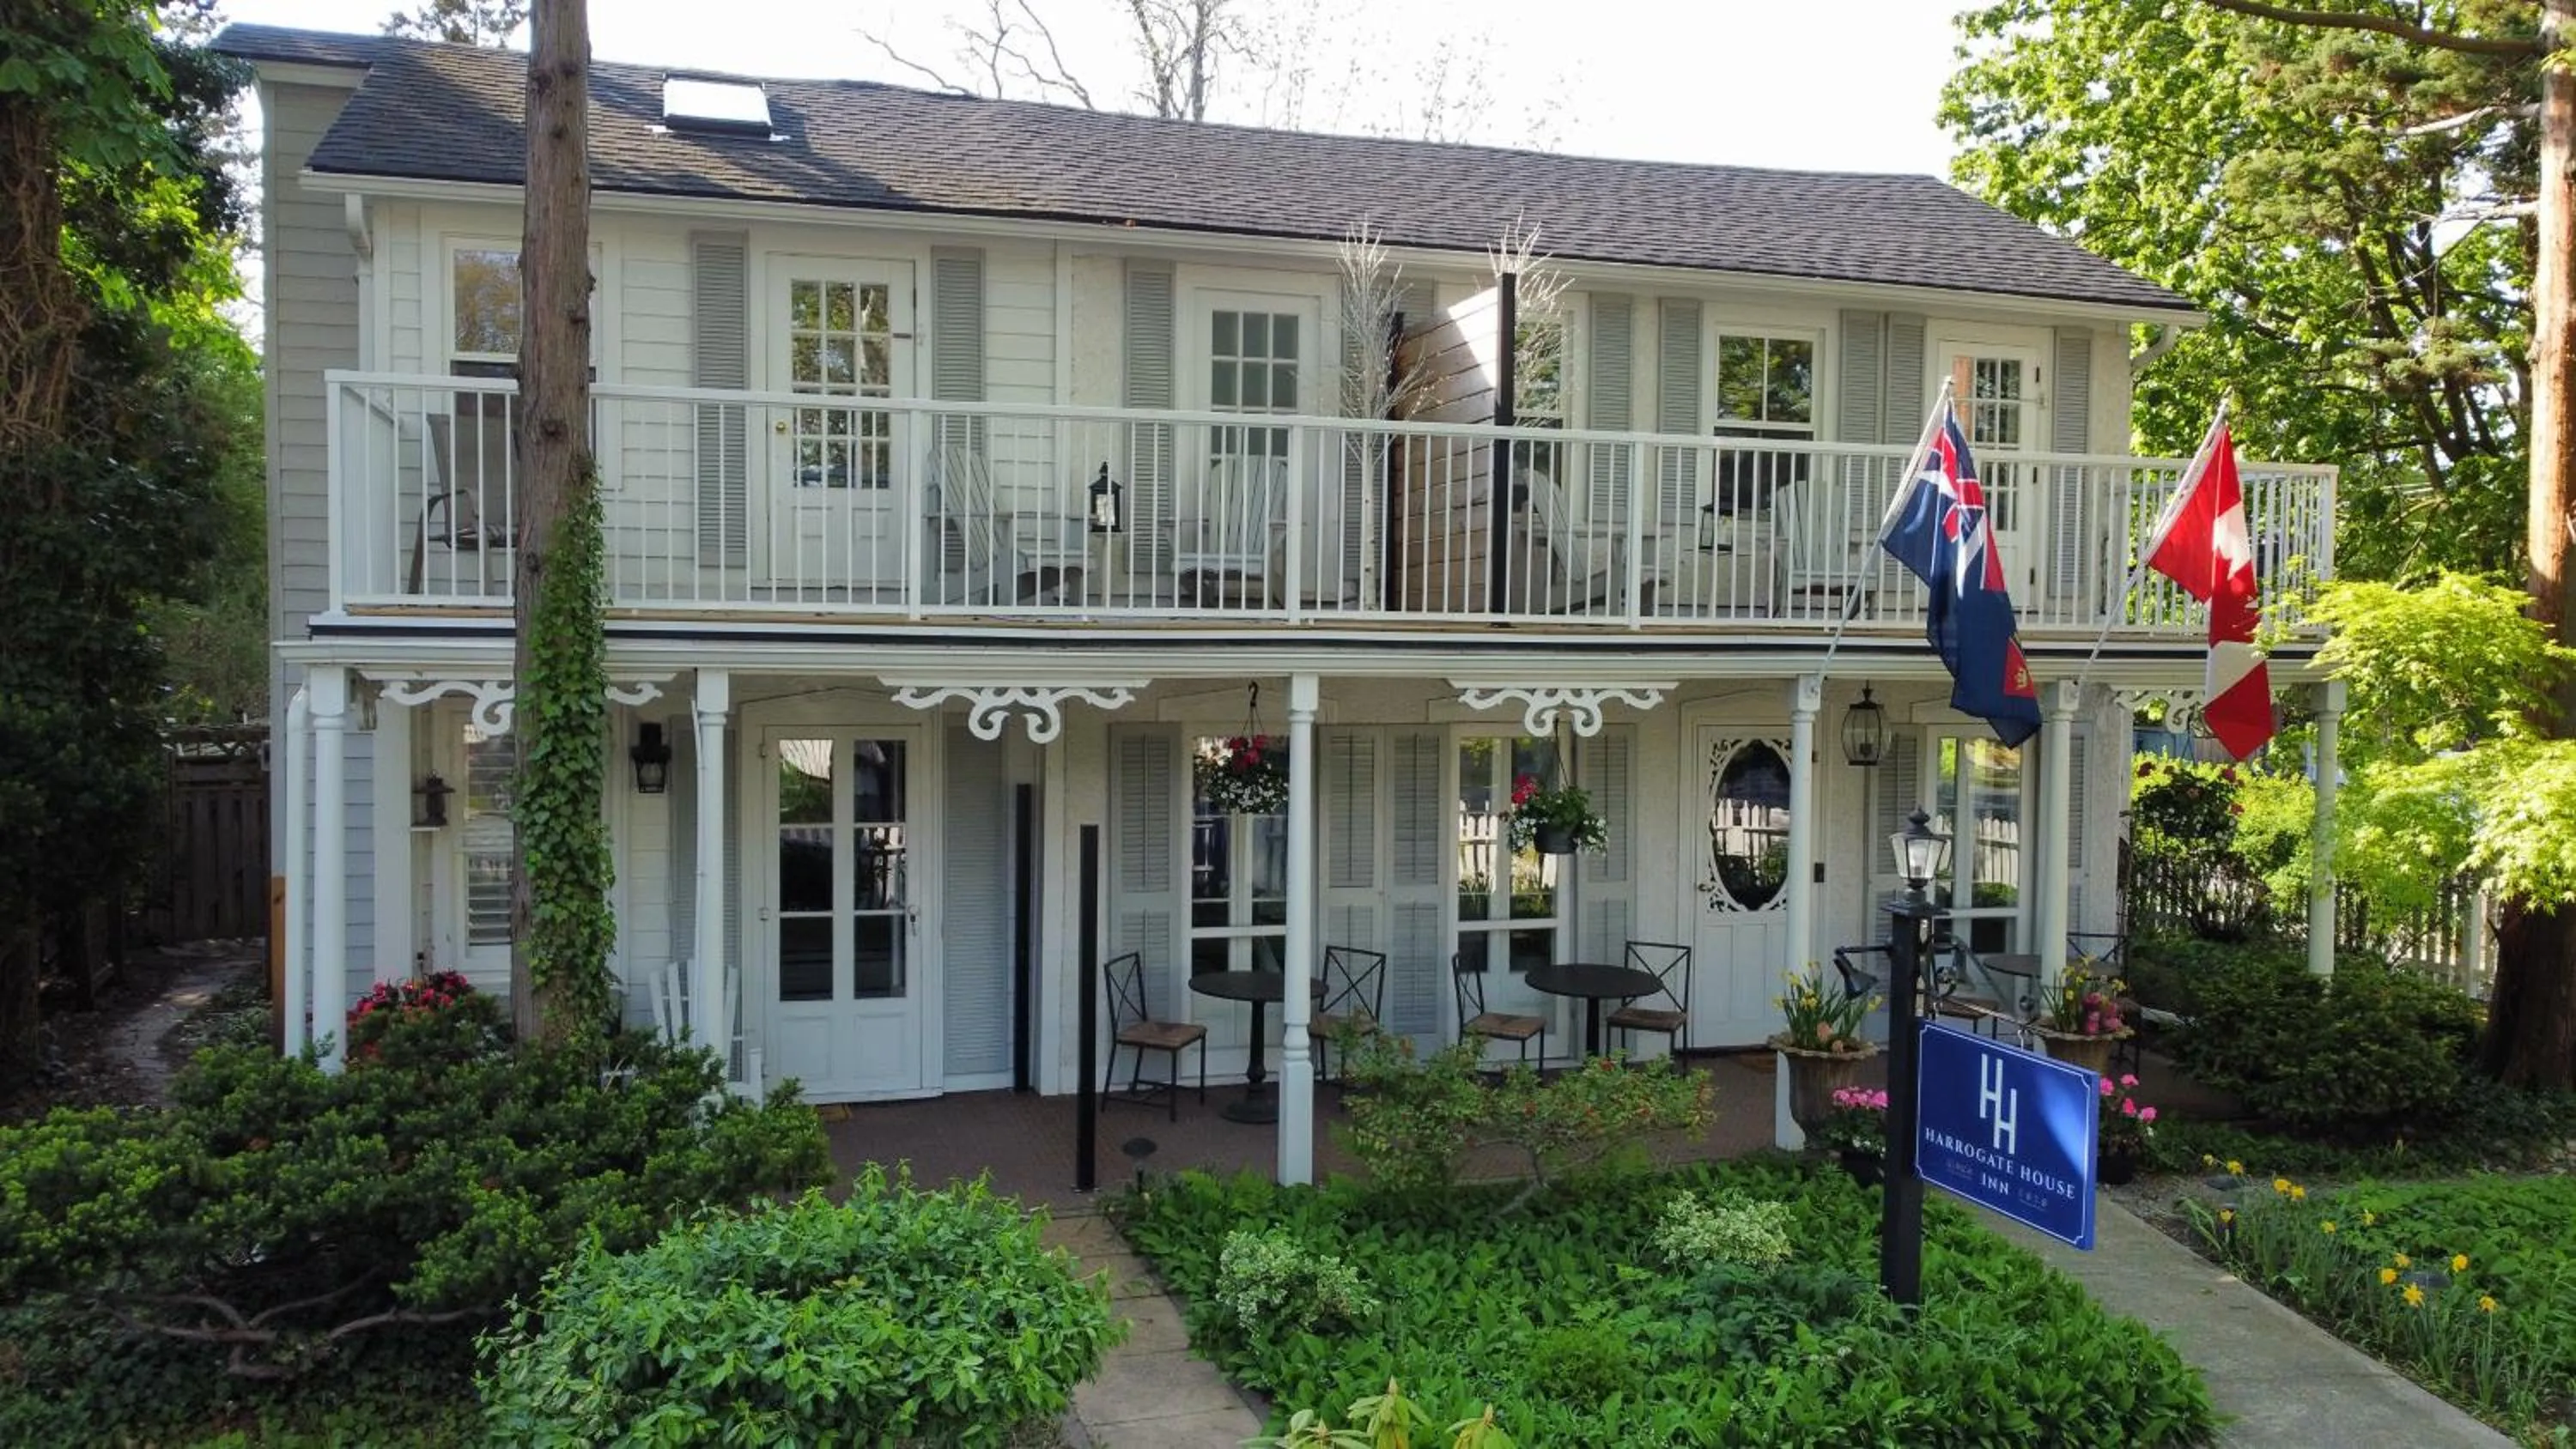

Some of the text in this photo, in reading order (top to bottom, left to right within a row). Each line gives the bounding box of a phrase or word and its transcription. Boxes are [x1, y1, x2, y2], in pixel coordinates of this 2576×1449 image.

[1925, 1127, 2014, 1176] HARROGATE
[2020, 1165, 2076, 1199] HOUSE
[1981, 1173, 2009, 1196] INN
